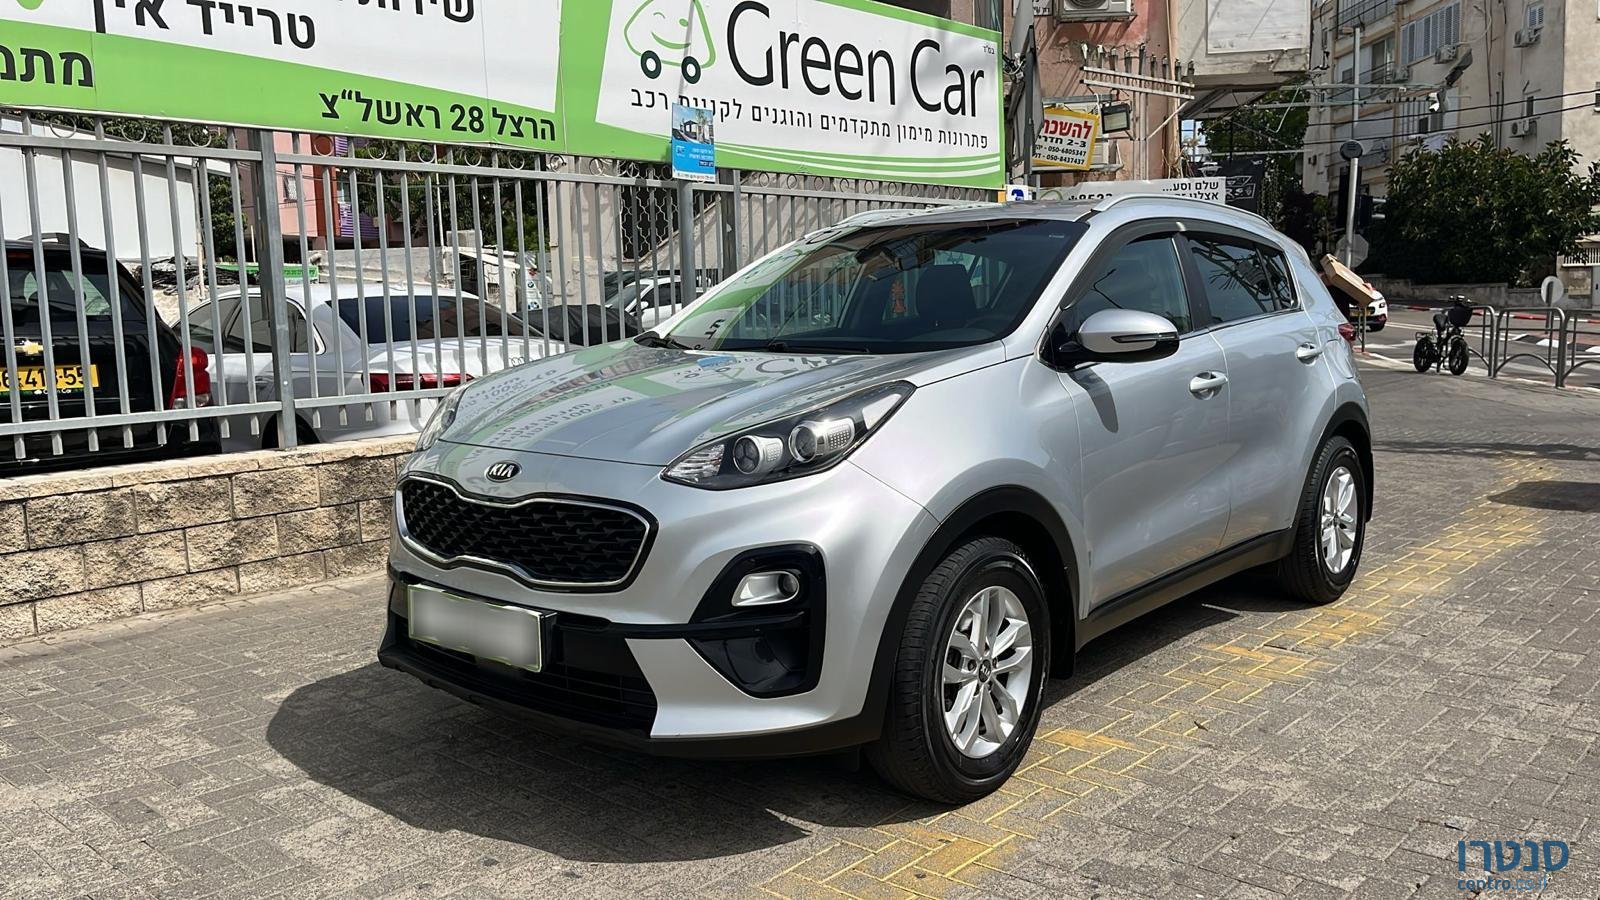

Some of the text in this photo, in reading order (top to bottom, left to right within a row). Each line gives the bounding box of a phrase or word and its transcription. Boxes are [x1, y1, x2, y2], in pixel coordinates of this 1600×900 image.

[187, 0, 315, 48] טרייד
[727, 0, 985, 117] Green Car
[450, 104, 484, 133] 28
[490, 107, 555, 144] הרצל
[632, 89, 987, 148] פתרונות מימון מתקדמים והוגנים לקניית רכב
[1195, 180, 1219, 190] שלם
[488, 463, 515, 478] KIA
